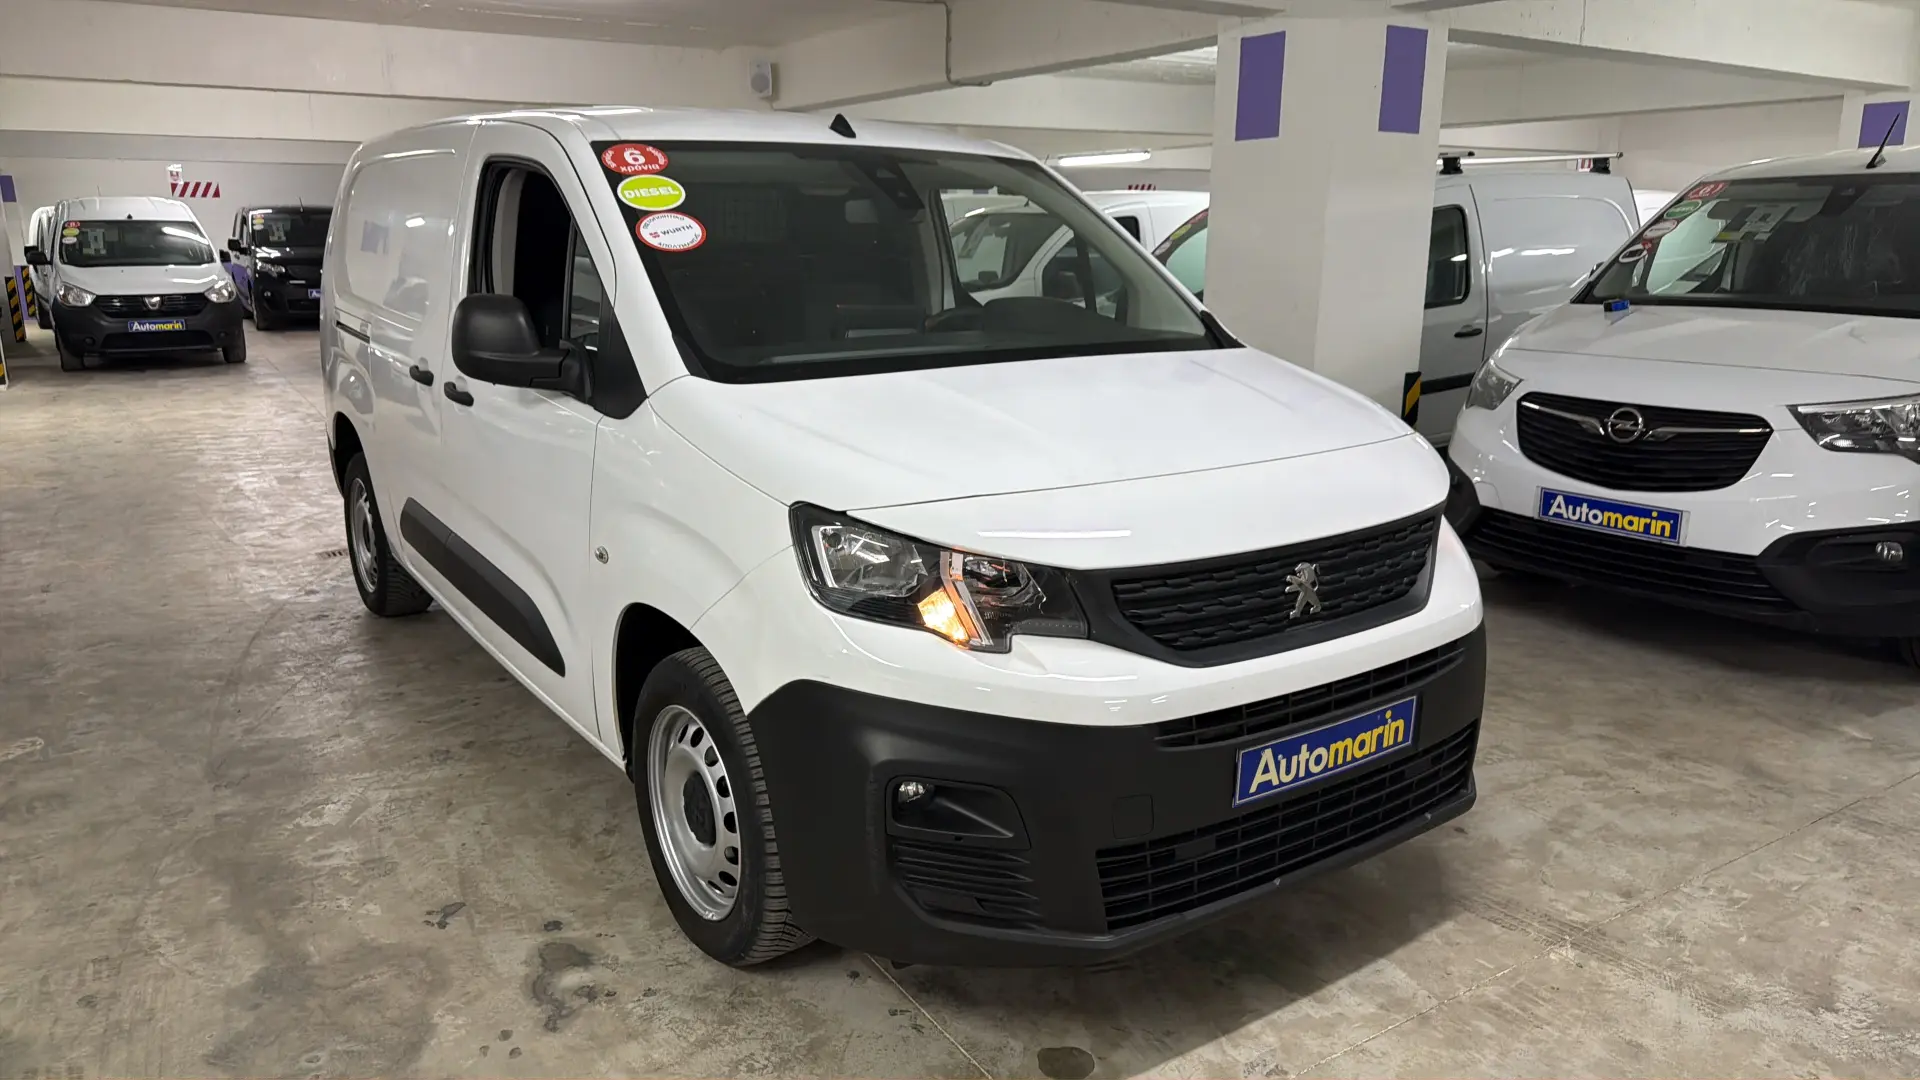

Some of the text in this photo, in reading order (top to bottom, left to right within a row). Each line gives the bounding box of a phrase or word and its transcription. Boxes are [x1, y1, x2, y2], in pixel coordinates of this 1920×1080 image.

[624, 150, 646, 165] 6
[624, 186, 679, 199] DIESEL
[132, 320, 183, 332] Automarin
[1548, 495, 1671, 538] Automarin
[1249, 709, 1404, 794] Automarin
